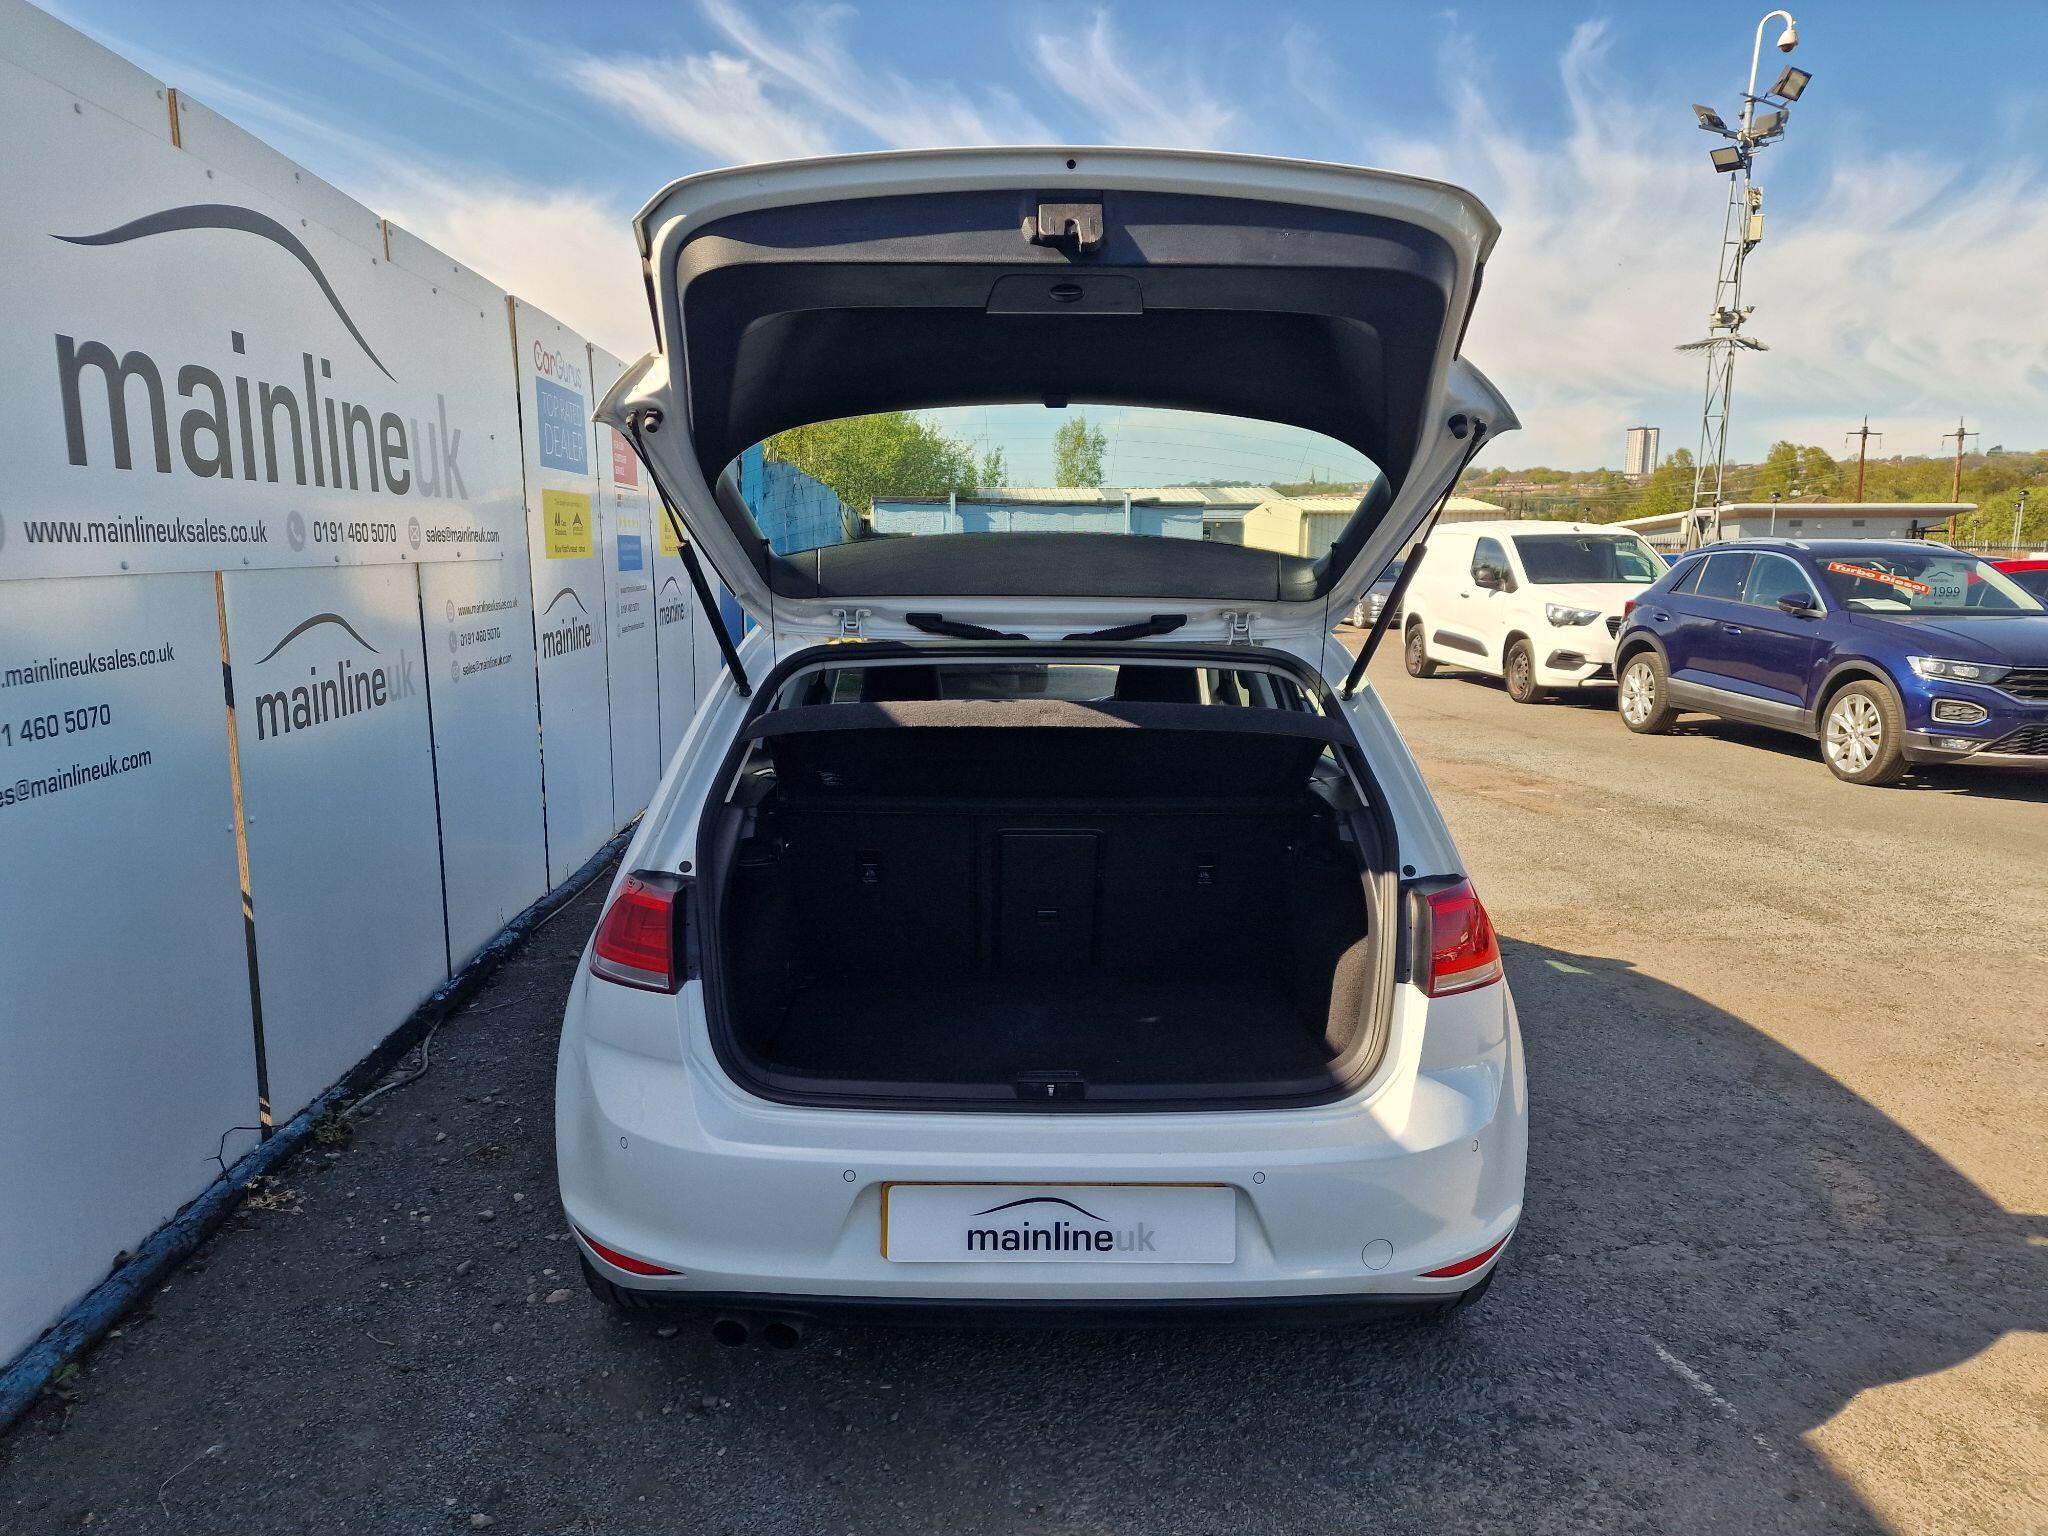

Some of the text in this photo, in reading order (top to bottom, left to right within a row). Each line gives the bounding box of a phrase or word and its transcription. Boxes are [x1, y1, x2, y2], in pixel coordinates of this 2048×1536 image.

[533, 340, 583, 388] CarGurus
[55, 330, 469, 500] mainlineuk
[541, 391, 559, 417] TOP
[544, 423, 585, 462] DEALER
[24, 515, 268, 543] www.mainlineuksales.co.uk
[313, 521, 397, 543] 0191 460 5070
[426, 526, 500, 543] sales@mainlineuk.com
[1834, 564, 1927, 592] Turbo Diesel
[1933, 586, 1961, 598] 1999
[255, 649, 416, 740] mainlineuk
[20, 714, 59, 742] 460
[64, 703, 111, 733] 5070
[967, 1221, 1157, 1252] mainlineuk
